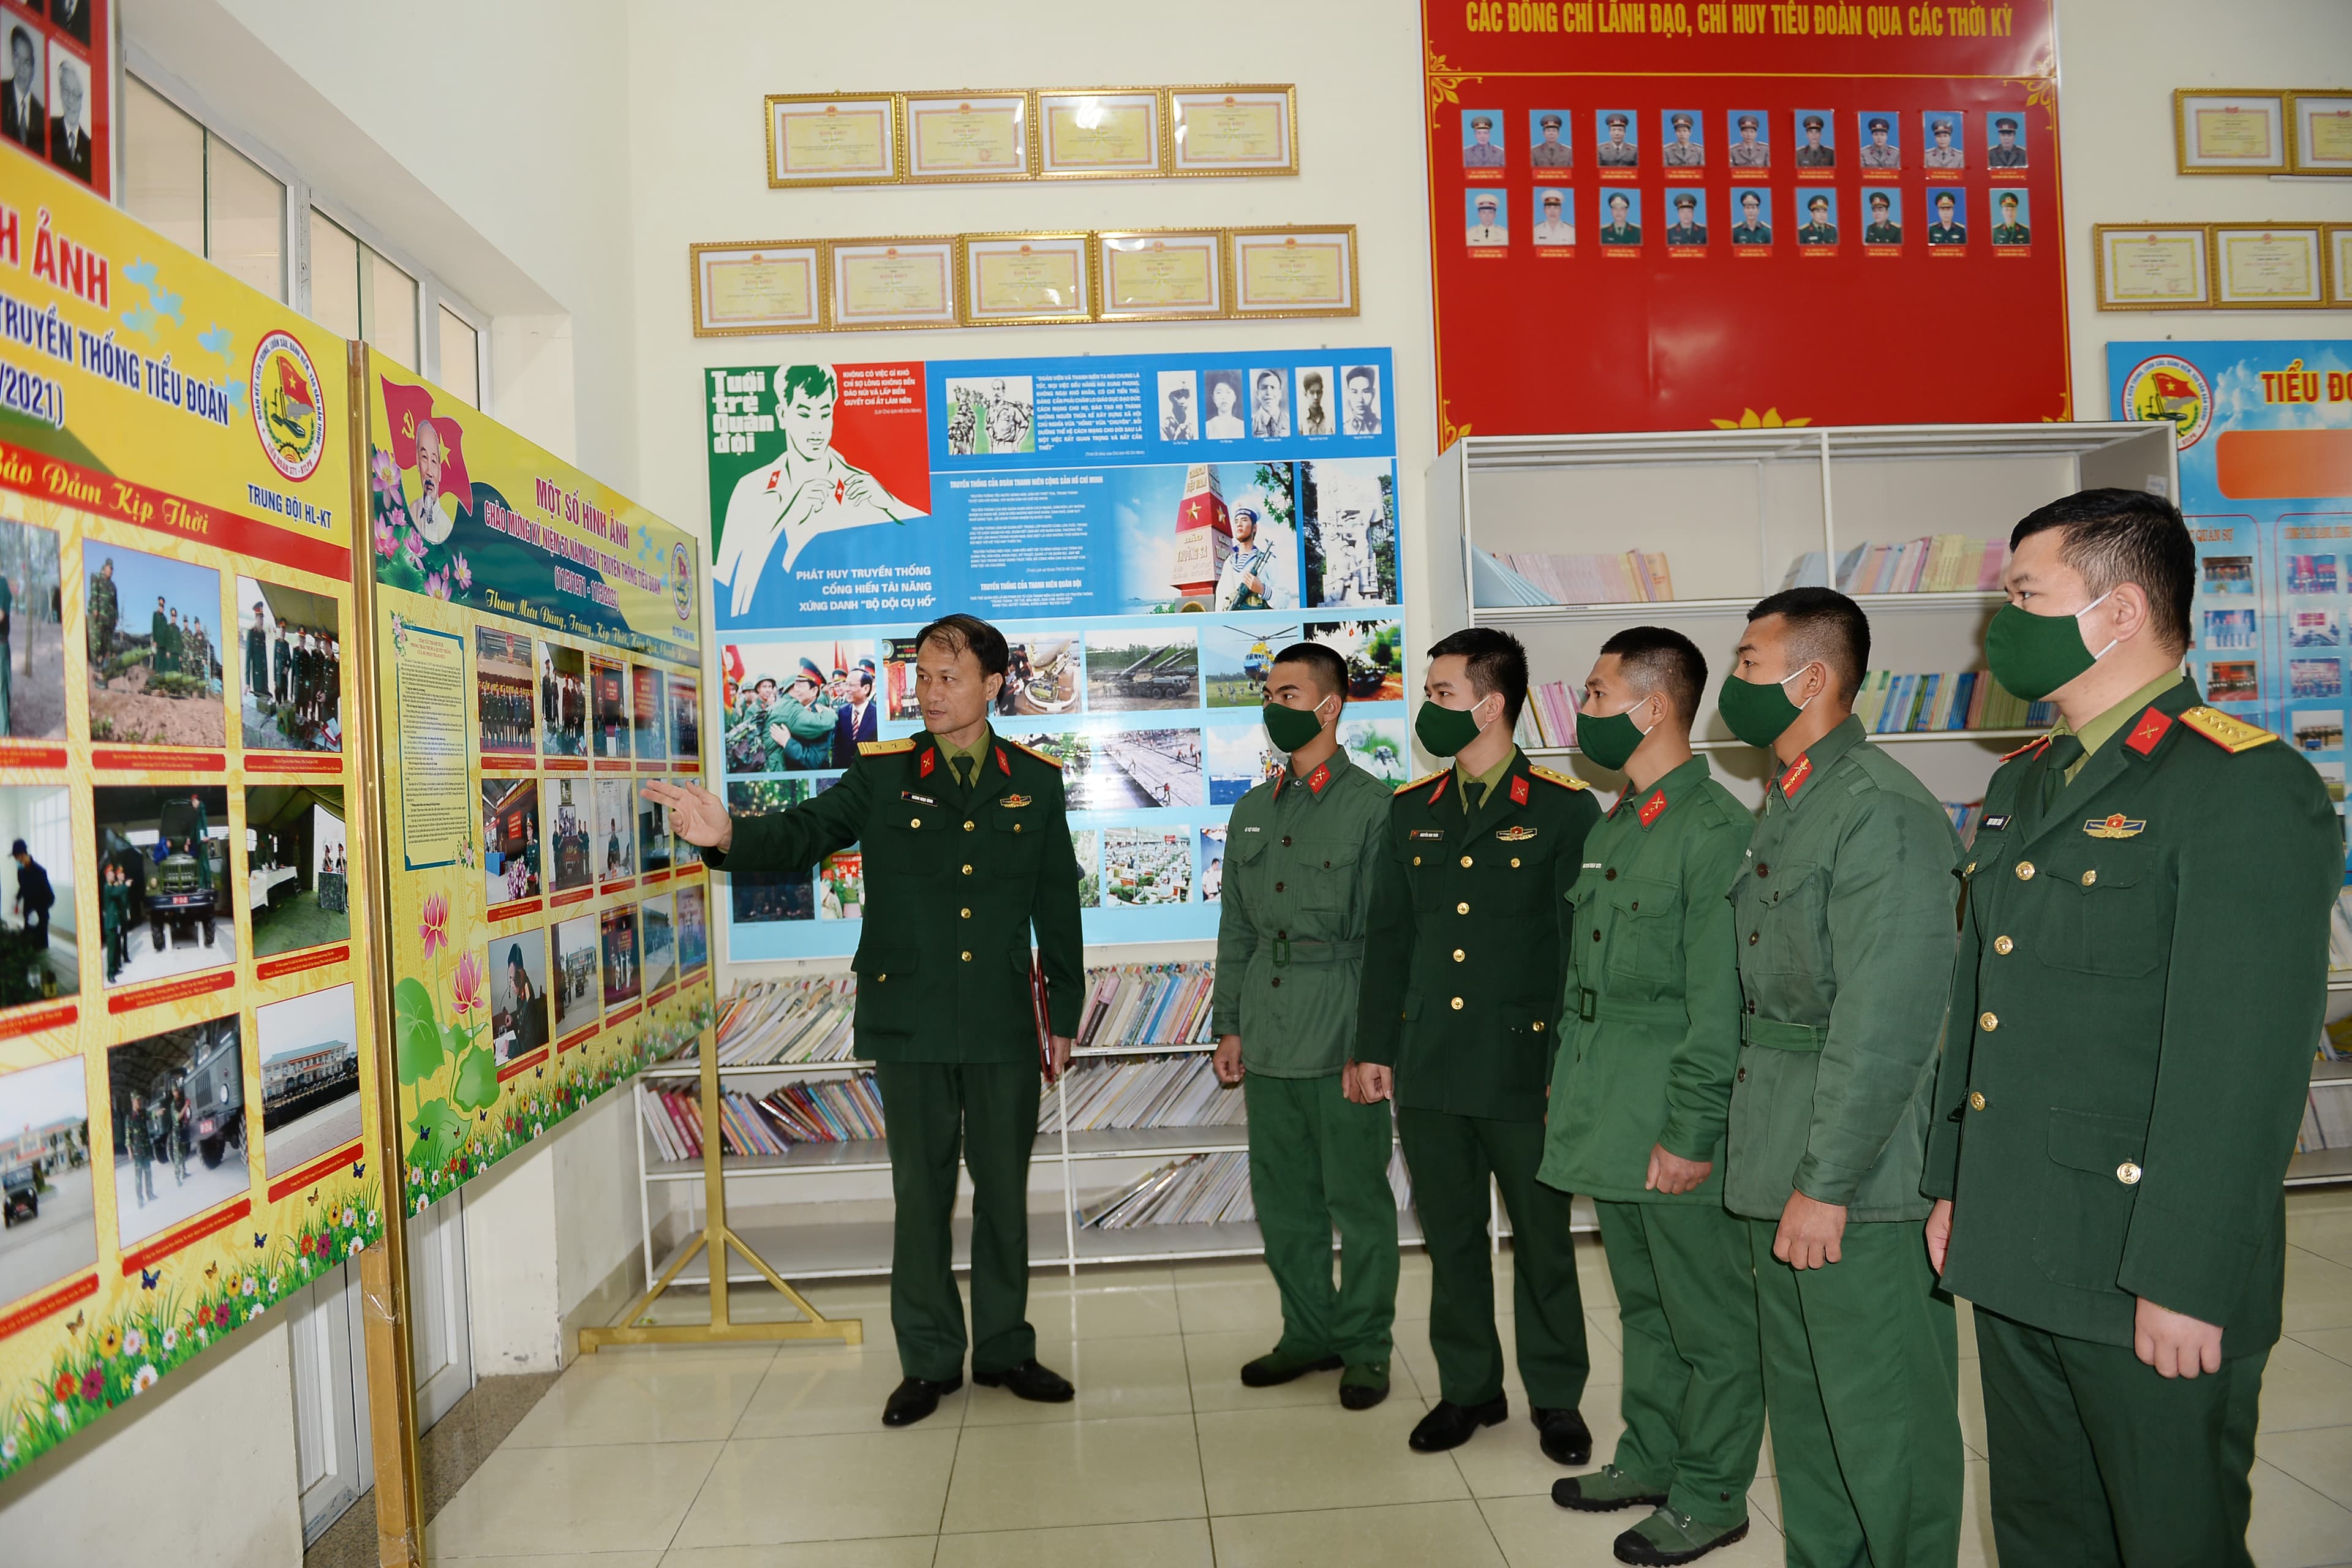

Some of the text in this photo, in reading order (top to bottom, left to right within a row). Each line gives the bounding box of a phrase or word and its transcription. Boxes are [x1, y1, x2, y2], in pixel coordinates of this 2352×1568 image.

[1466, 0, 1503, 32] CÁC
[1563, 0, 1593, 32] CHÍ
[1650, 2, 1692, 38] ĐẠO,
[1697, 0, 1727, 33] CHÍ
[1732, 4, 1766, 34] HUY
[1814, 2, 1863, 35] ĐOÀN
[1867, 6, 1902, 39] QUA
[1908, 1, 1943, 36] CÁC
[1947, 0, 1986, 37] THỜI
[32, 208, 108, 308] ẢNH
[77, 330, 140, 389] THỐNG
[145, 355, 181, 405] TIỂU
[186, 375, 228, 426] ĐOÀN
[710, 370, 766, 393] Tuổi
[858, 388, 869, 396] NÚI
[864, 378, 880, 386] LÒNG
[875, 369, 888, 378] VIỆC
[889, 368, 896, 377] GÌ
[2261, 358, 2319, 403] TIỂU
[0, 362, 63, 426] /2021)
[712, 391, 759, 413] trẻ
[844, 397, 864, 406] QUYẾT
[899, 396, 912, 404] NÊN
[714, 432, 755, 456] đội
[42, 462, 102, 507] Đảm
[109, 482, 154, 525] Kịp
[161, 497, 209, 534] Thời
[247, 483, 332, 529] TRUNG ĐỘI HL-KT
[536, 477, 628, 549] MỘT SỐ HÌNH ẢNH
[484, 500, 506, 532] CHÀO
[507, 510, 530, 542] MỪNG
[543, 527, 560, 557] NIỆM
[560, 539, 569, 559] 50
[570, 537, 584, 565] NĂM
[584, 545, 600, 571] NGÀY
[601, 552, 620, 579] TRUYỀN
[621, 558, 637, 586] THỐNG
[554, 565, 586, 598] (11/3/1971
[590, 579, 619, 612] 11/3/2021)
[796, 563, 932, 581] PHÁT HUY TRUYỀN THỐNG
[822, 581, 932, 595] CỐNG HIẾN TÀI NĂNG
[485, 589, 515, 614] Tham
[517, 599, 537, 621] Mưu
[540, 606, 567, 630] Đúng,
[569, 614, 594, 638] Trúng,
[595, 622, 609, 644] Kịp
[612, 627, 629, 647] Thời,
[799, 599, 828, 612] XỨNG
[830, 600, 858, 611] DANH
[881, 597, 899, 610] ĐỘI
[900, 598, 915, 610] CỤ
